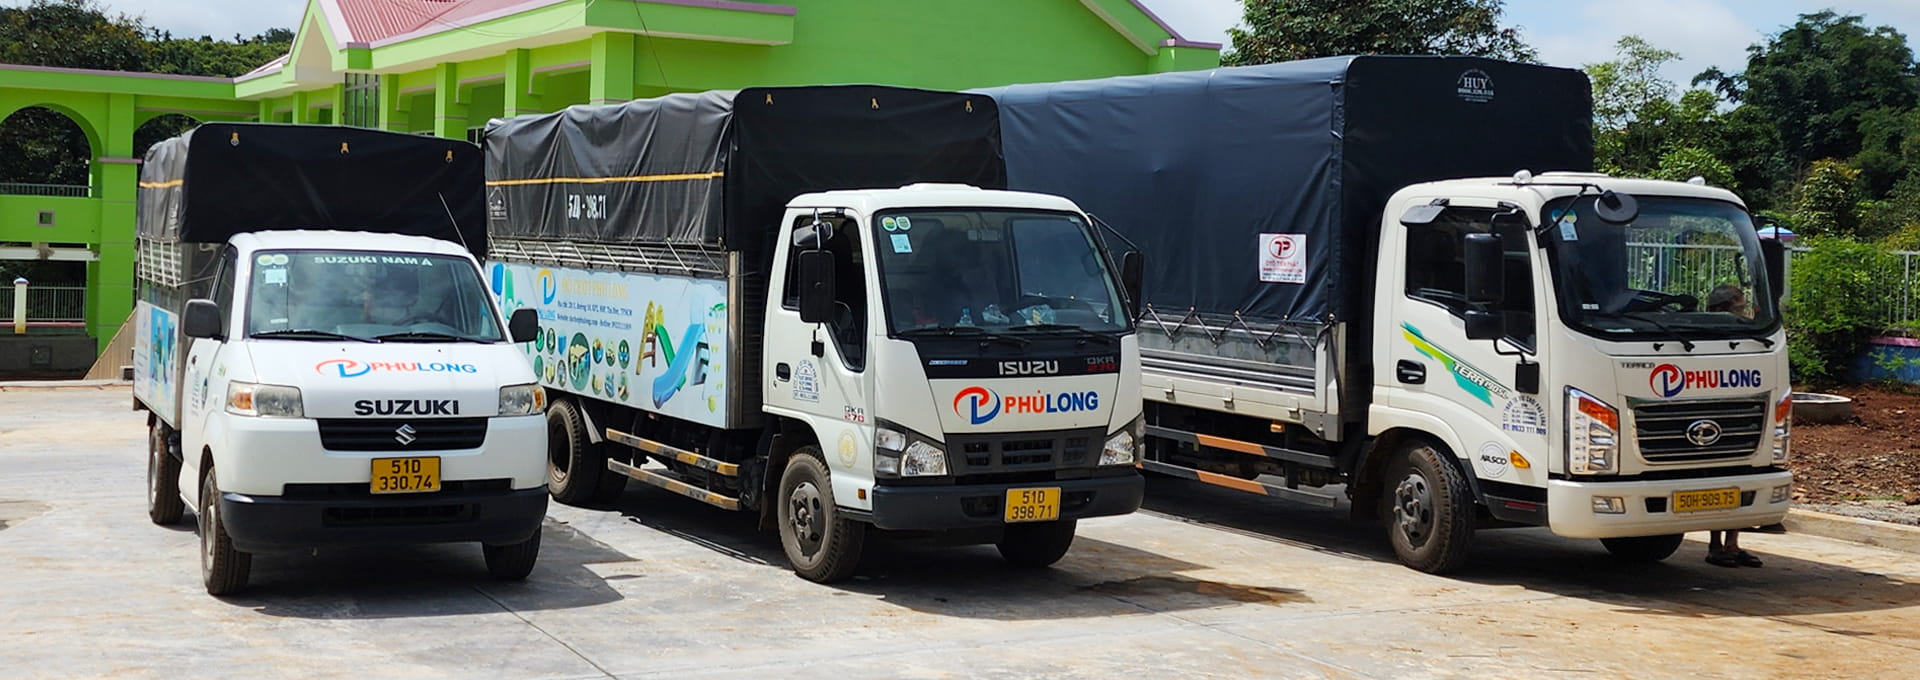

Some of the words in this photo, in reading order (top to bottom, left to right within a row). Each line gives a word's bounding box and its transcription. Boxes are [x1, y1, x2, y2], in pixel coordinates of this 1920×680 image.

[1464, 77, 1488, 89] HUY
[314, 256, 377, 264] SUZUKI
[382, 256, 418, 265] NAM
[998, 360, 1059, 375] ISUZU
[354, 400, 459, 416] SUZUKI
[844, 414, 865, 423] 270
[391, 460, 421, 474] 51D
[379, 475, 432, 490] 330.74
[1022, 490, 1045, 504] 51D
[1680, 492, 1735, 508] 50H-909.75
[1012, 505, 1052, 519] 398.71
